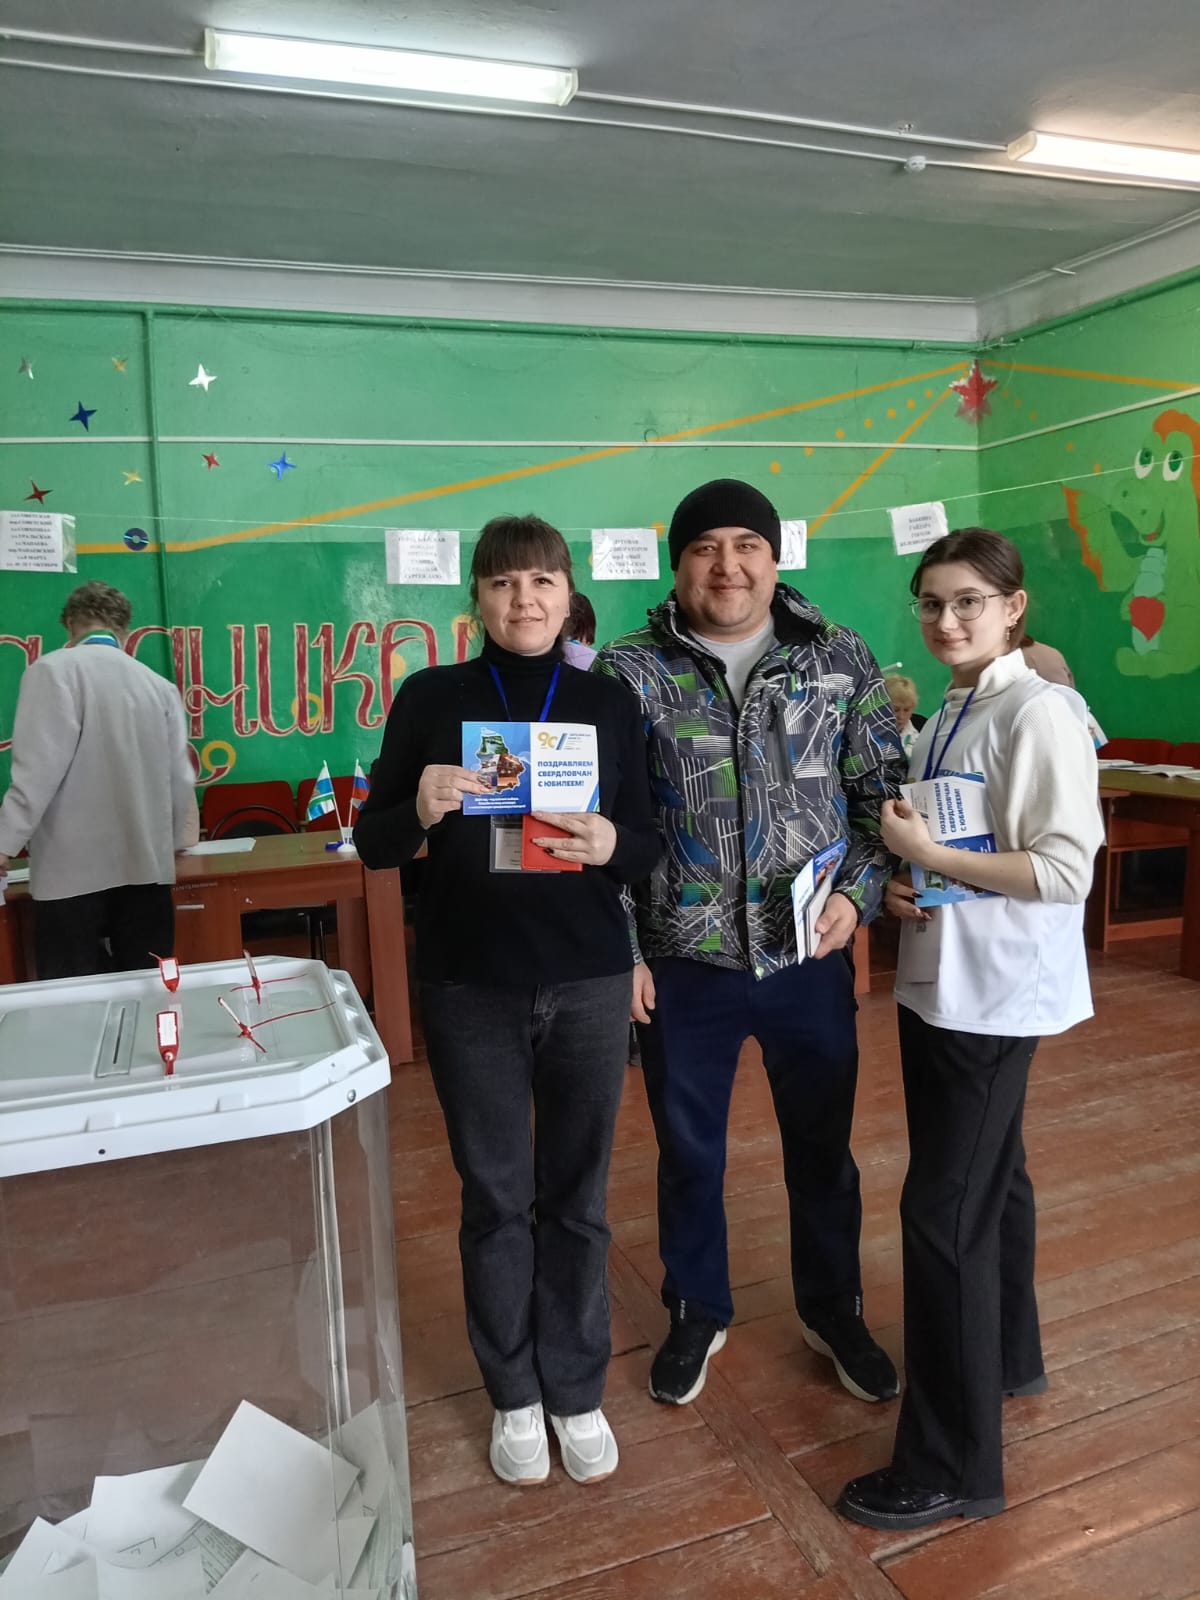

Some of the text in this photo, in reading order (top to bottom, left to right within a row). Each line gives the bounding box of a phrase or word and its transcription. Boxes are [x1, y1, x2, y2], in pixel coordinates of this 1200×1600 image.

[934, 782, 947, 834] ПОЗДРАВЛЯЕМ
[944, 782, 957, 832] СВЕРДЛОВЧАН
[954, 788, 966, 826] ЮБИЛЕЕМ!
